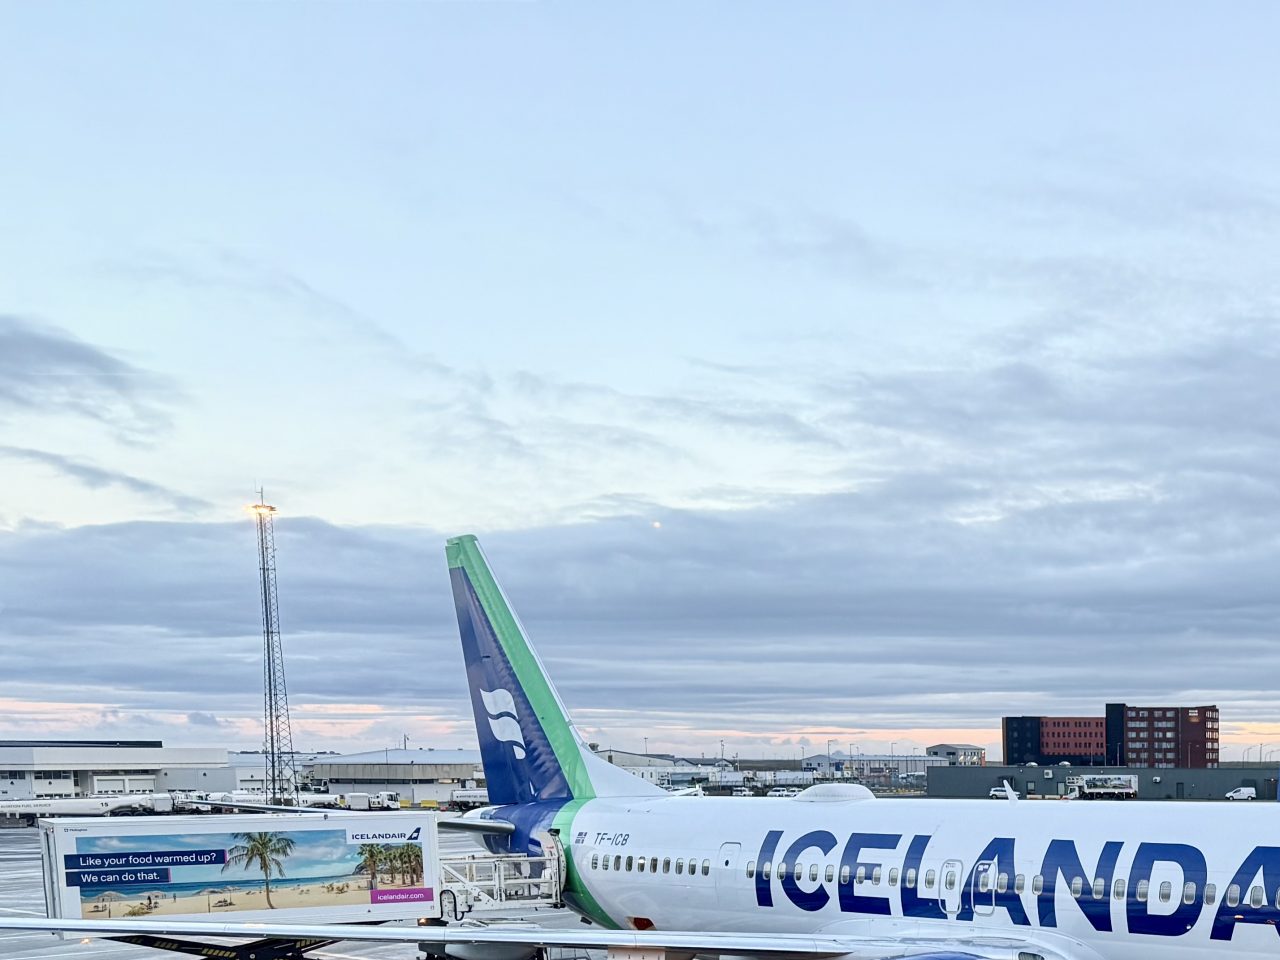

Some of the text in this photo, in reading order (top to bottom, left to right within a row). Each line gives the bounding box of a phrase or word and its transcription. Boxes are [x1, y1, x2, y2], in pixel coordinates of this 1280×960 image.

[351, 832, 407, 840] ICELANDAIR
[594, 832, 630, 846] TF-ICB
[80, 852, 217, 867] Like your food warmed up?
[80, 871, 160, 883] We can do that.
[377, 891, 425, 900] icelandair.com
